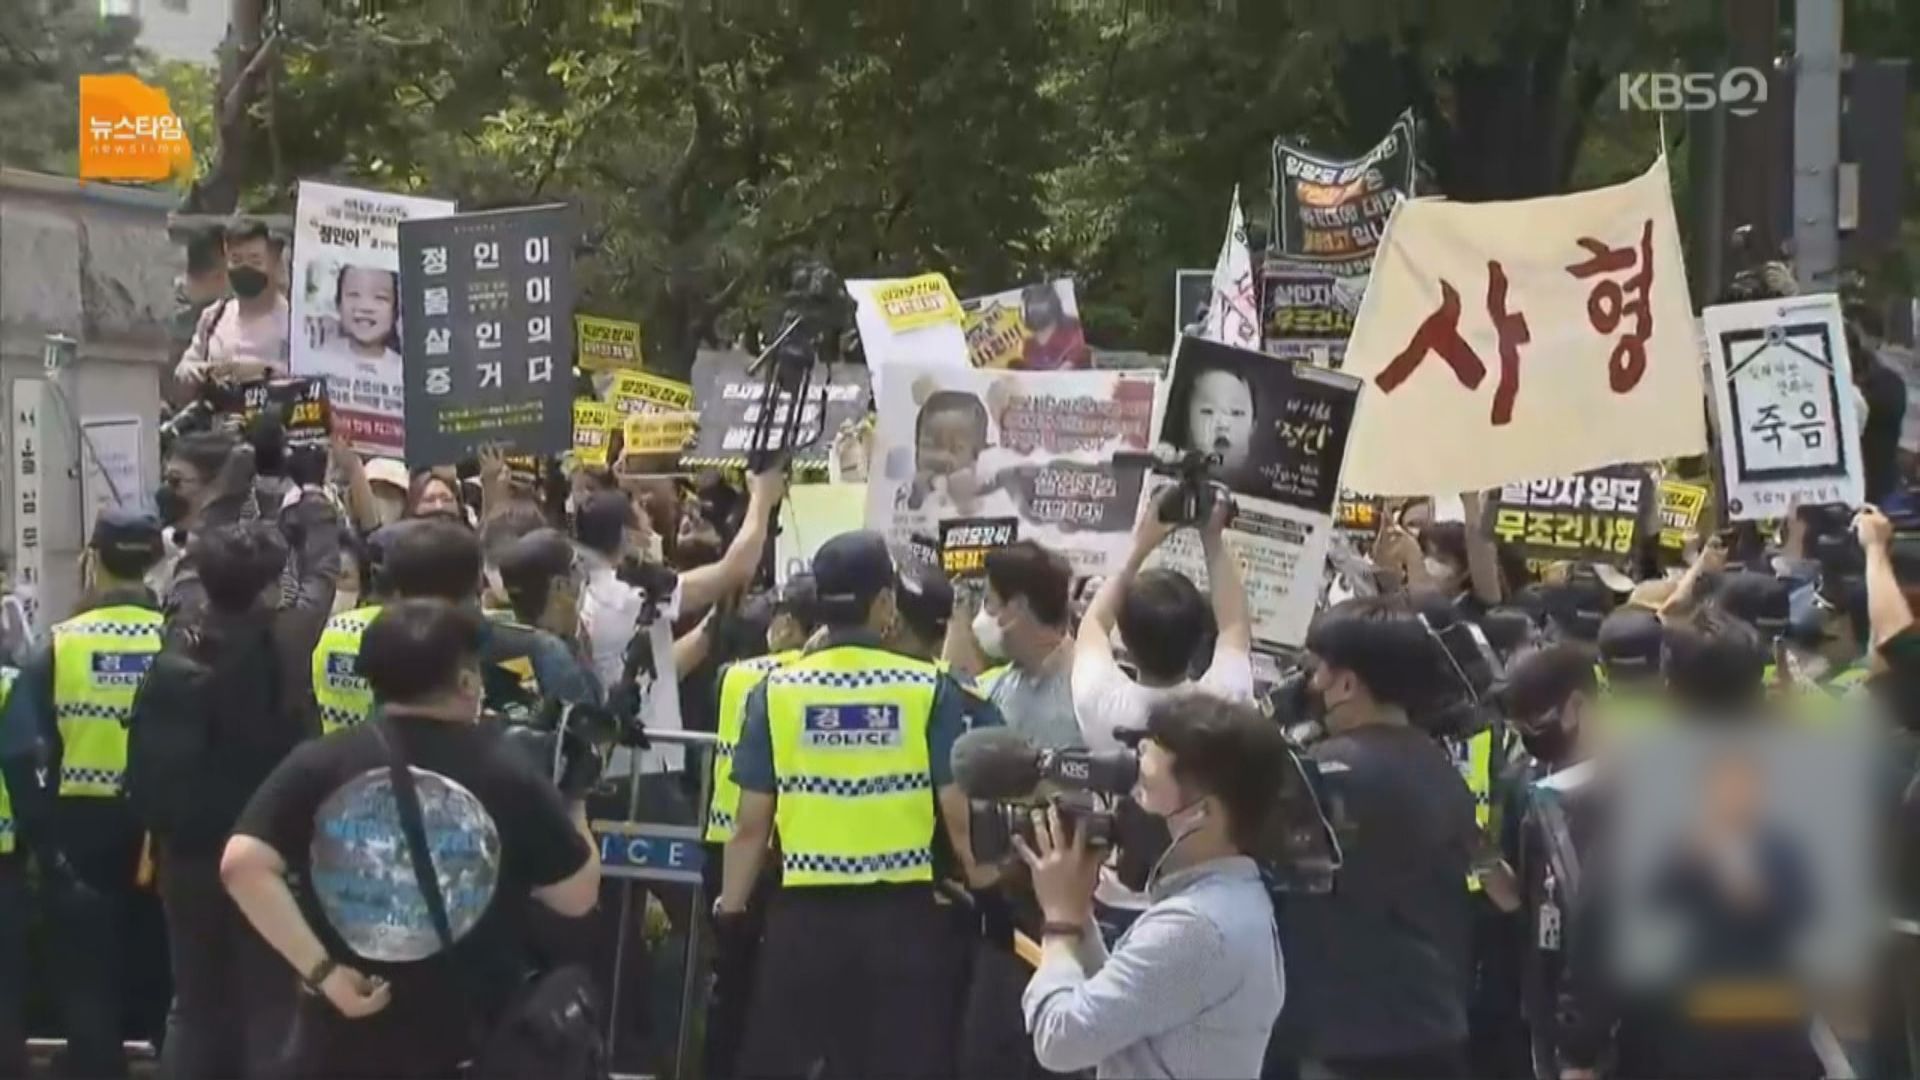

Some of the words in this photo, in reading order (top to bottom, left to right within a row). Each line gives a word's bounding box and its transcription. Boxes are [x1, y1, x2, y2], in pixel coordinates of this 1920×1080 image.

[421, 237, 550, 275] 정인이
[425, 315, 552, 355] 살인의
[1374, 219, 1653, 426] 사형
[426, 356, 554, 394] 증거다
[1751, 402, 1826, 452] 죽음
[1501, 476, 1584, 507] 살인자
[813, 706, 891, 729] 경찰
[812, 732, 891, 745] POLICE
[1061, 760, 1090, 779] KBS
[601, 836, 684, 866] ICE
